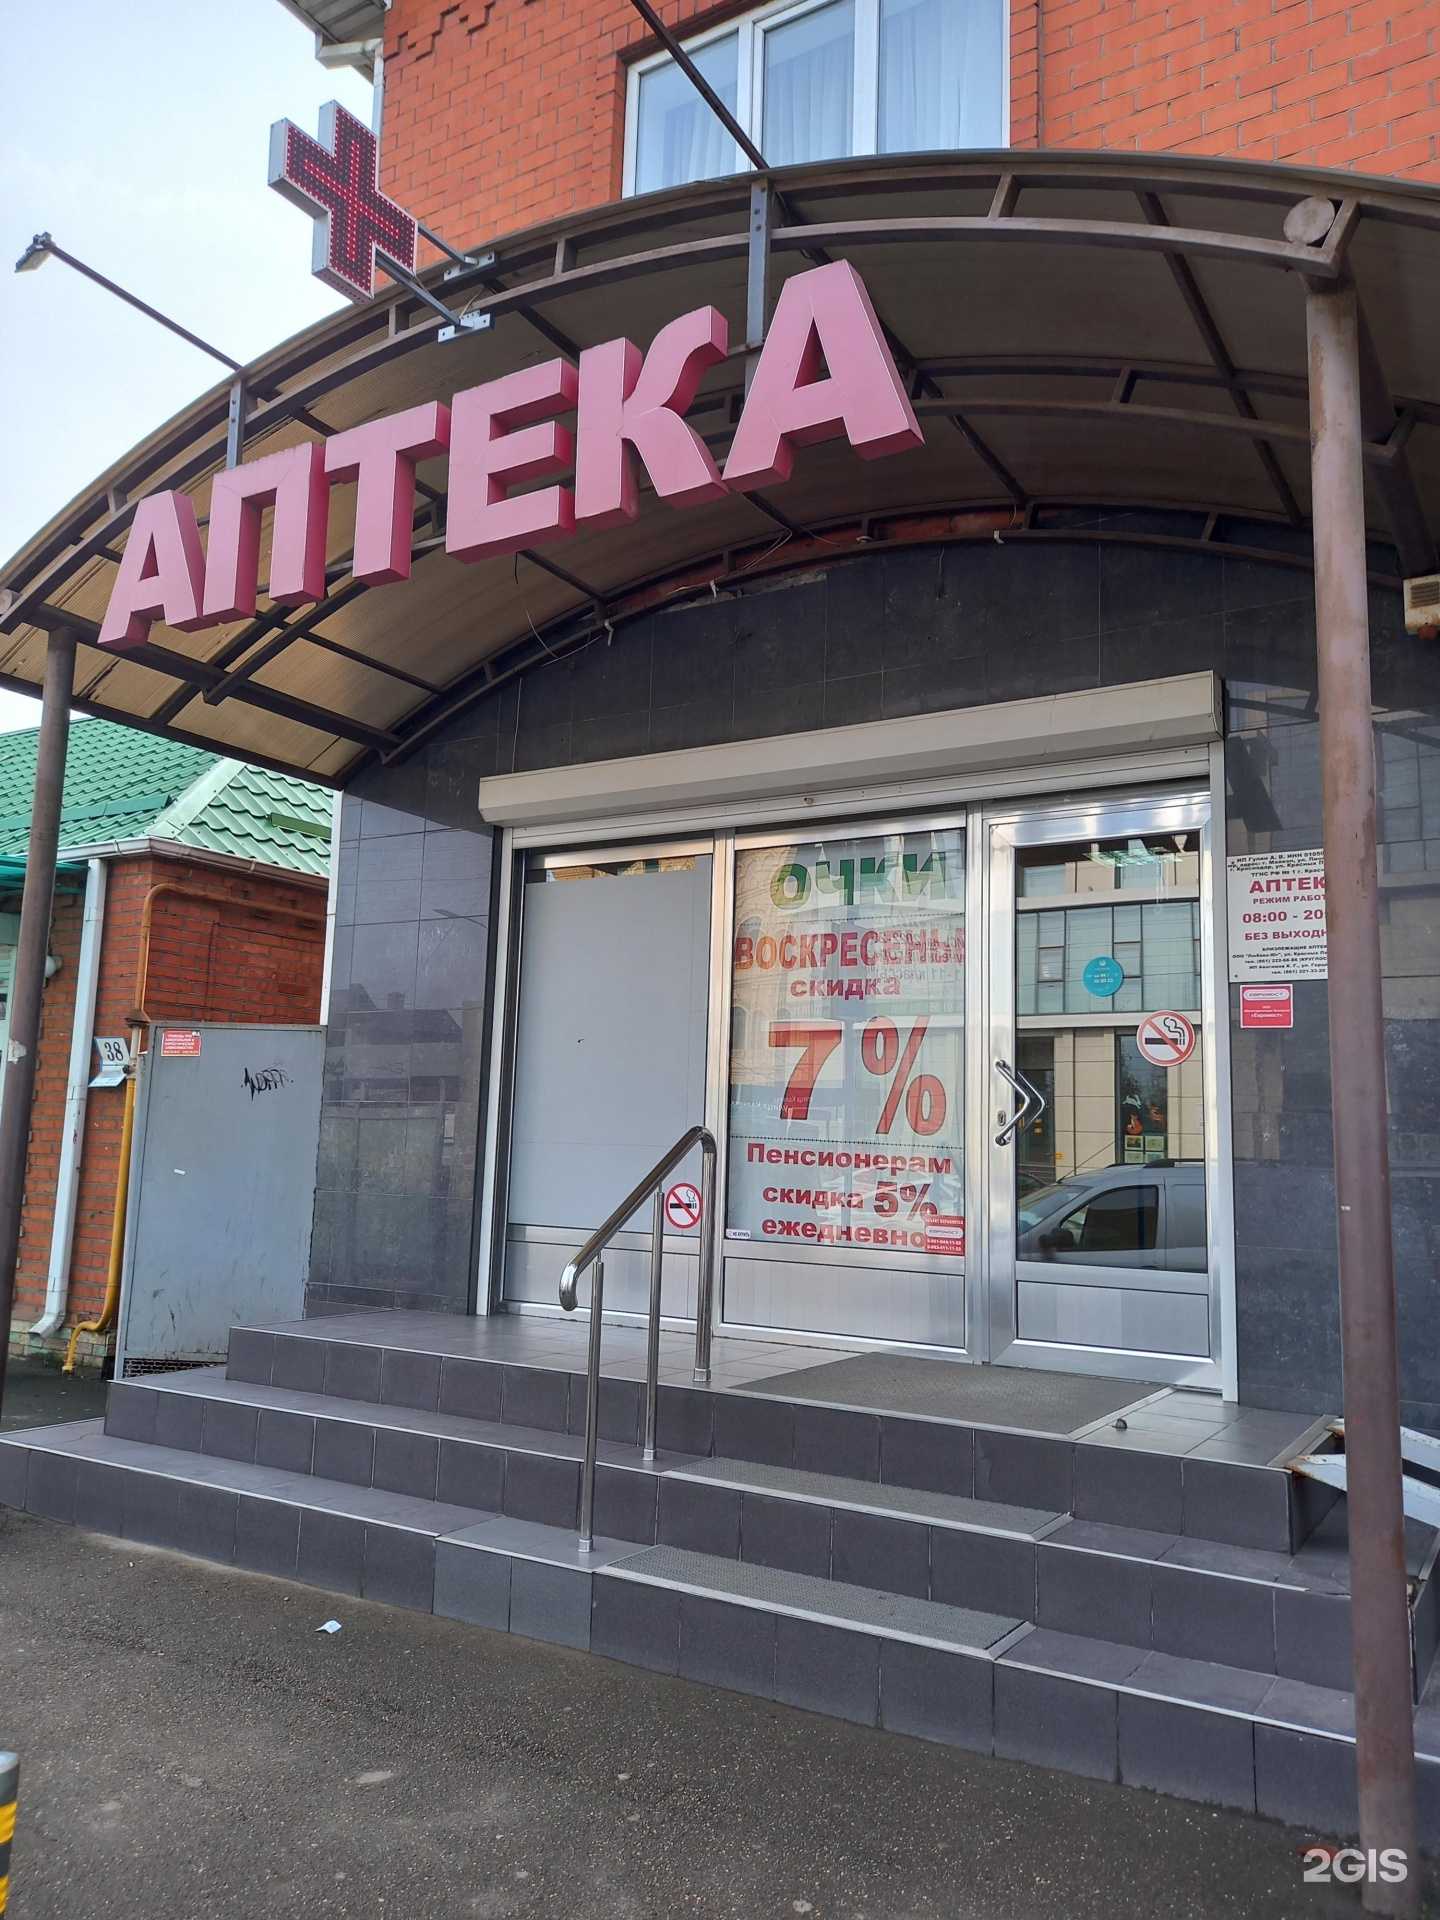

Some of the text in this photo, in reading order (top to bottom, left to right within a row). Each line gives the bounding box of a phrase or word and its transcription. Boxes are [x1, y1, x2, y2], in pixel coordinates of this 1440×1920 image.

[97, 259, 924, 650] АПТЕКА
[1249, 876, 1326, 894] АПТЕК
[1253, 894, 1327, 904] РЕЖИМ РАБОТ
[1242, 911, 1287, 924] 08:00
[1245, 930, 1328, 940] БЕЗ ВЫХОДН
[790, 976, 901, 1000] скидка
[104, 1041, 124, 1062] 38
[747, 1143, 951, 1176] Пенсионерам
[762, 1181, 938, 1220] скидка 5%
[761, 1219, 926, 1248] ежедневно
